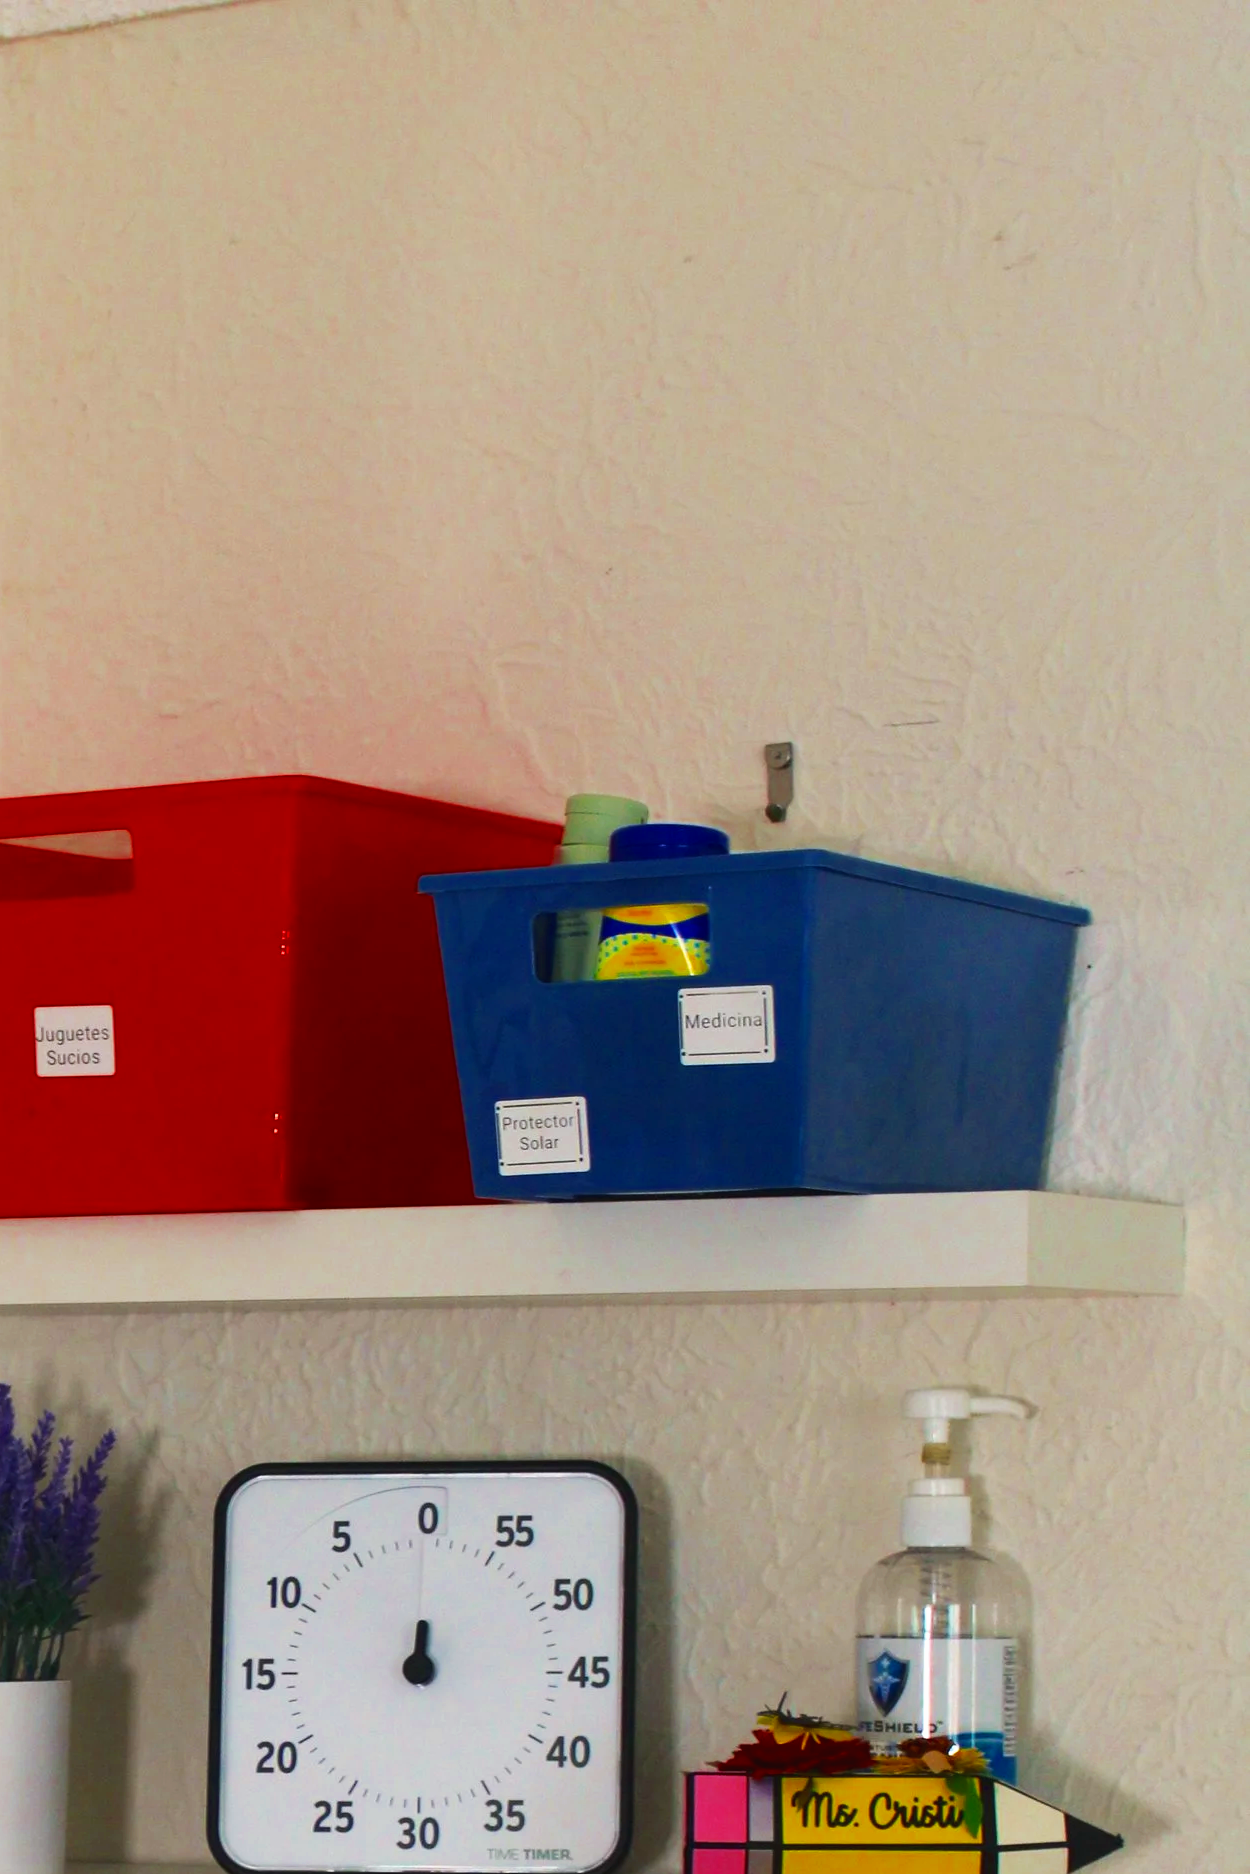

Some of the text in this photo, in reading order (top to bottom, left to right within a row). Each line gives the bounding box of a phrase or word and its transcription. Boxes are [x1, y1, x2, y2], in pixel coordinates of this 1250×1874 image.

[35, 1026, 110, 1045] Juguetes
[685, 1010, 764, 1030] Medicina
[47, 1048, 101, 1066] Sucios
[501, 1113, 575, 1132] Protector
[519, 1133, 559, 1152] Solar
[418, 1502, 439, 1534] 0
[496, 1515, 534, 1547] 55
[332, 1521, 351, 1552] 5
[267, 1576, 301, 1609] 10
[553, 1579, 594, 1611] 50
[242, 1658, 276, 1690] 15
[568, 1656, 610, 1689] 45
[256, 1741, 297, 1774] 20
[546, 1735, 591, 1768] 40
[313, 1800, 354, 1833] 25
[484, 1800, 526, 1832] 35
[792, 1790, 964, 1830] Ms. Cristi
[396, 1817, 440, 1850] 30
[486, 1848, 519, 1861] TIME
